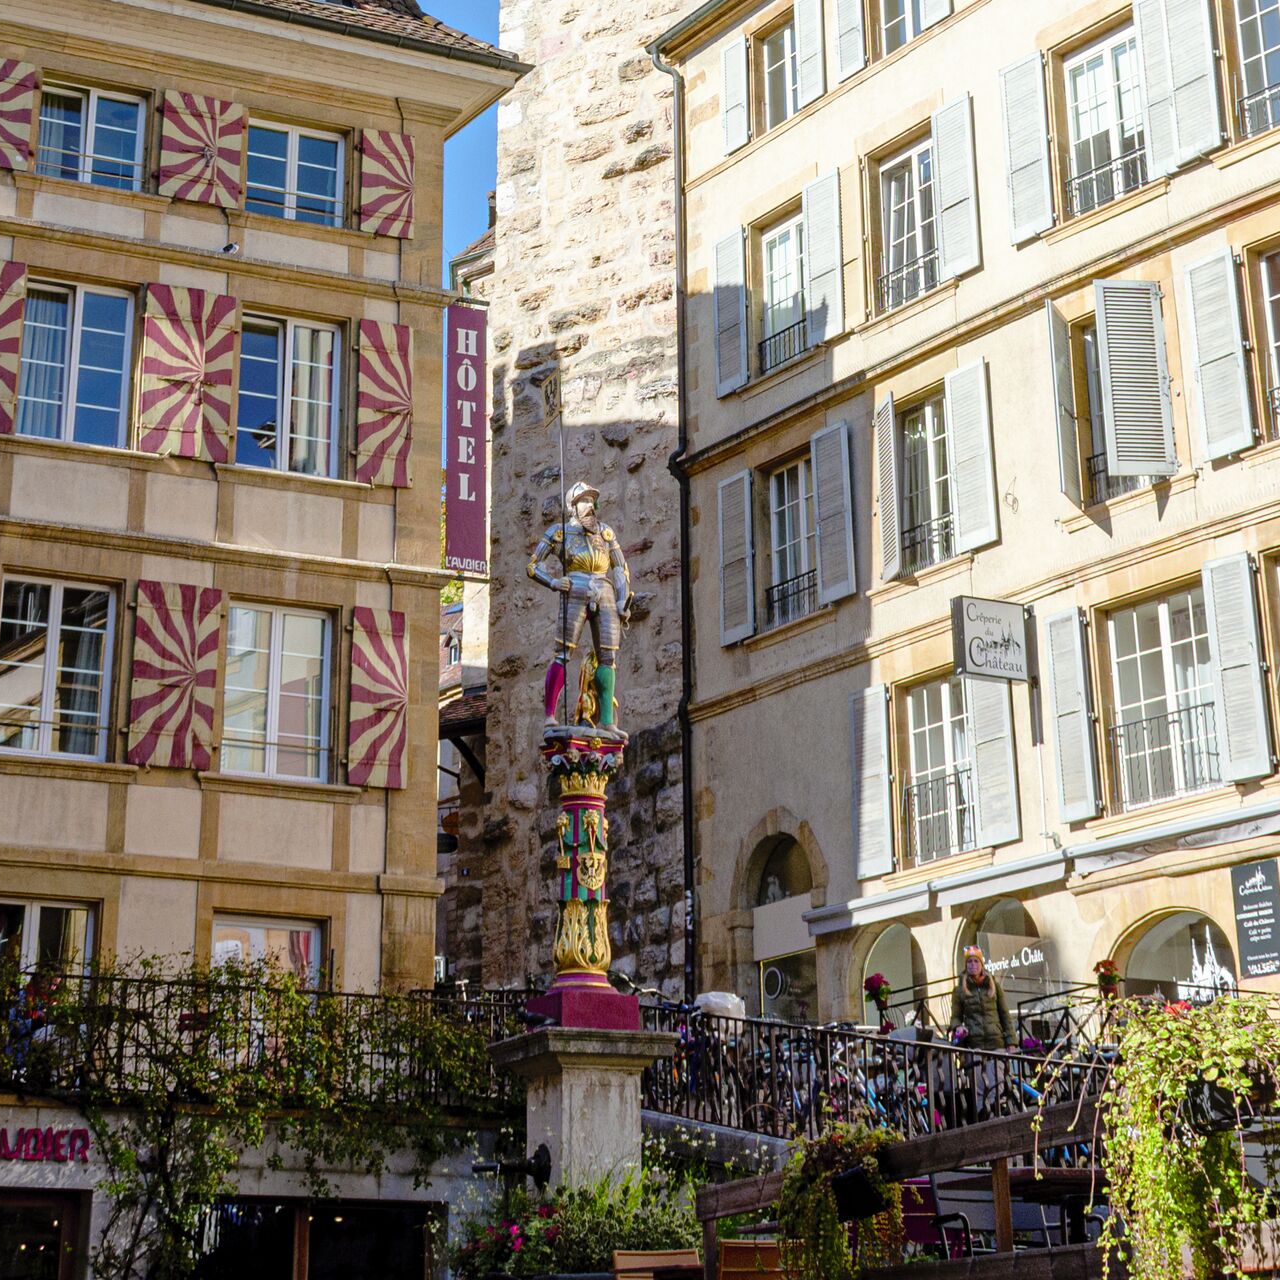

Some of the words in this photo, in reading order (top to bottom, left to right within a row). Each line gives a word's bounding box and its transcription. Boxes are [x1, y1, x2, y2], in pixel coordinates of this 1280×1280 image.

[456, 327, 478, 502] HÔTEL
[445, 555, 488, 572] L'AUBIER
[966, 602, 1002, 626] Crêperie
[984, 627, 994, 637] du
[968, 636, 1024, 673] Château
[1010, 954, 1020, 968] du
